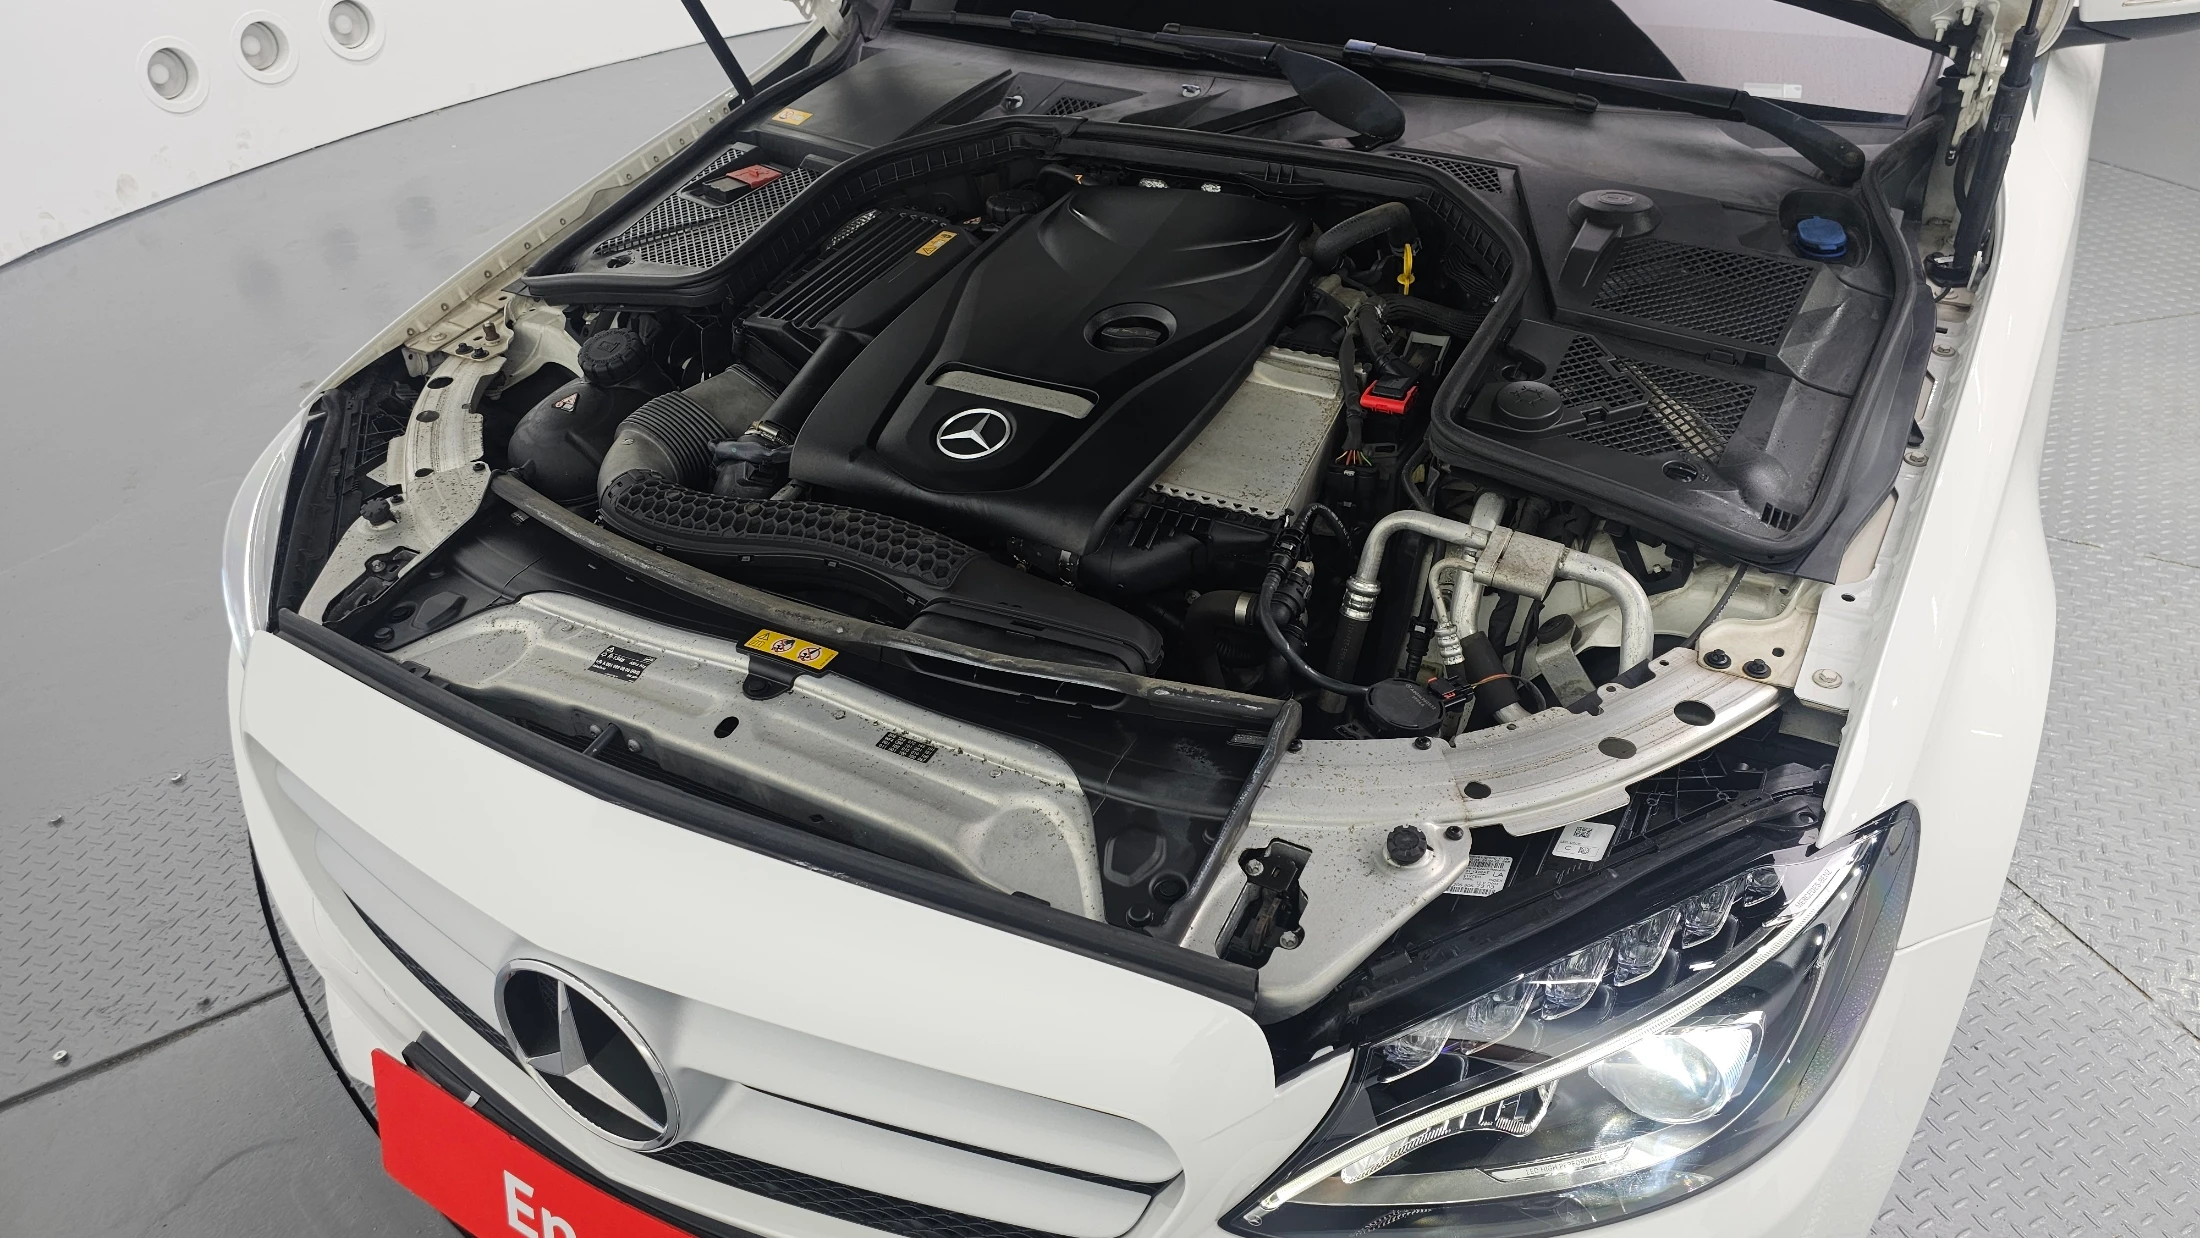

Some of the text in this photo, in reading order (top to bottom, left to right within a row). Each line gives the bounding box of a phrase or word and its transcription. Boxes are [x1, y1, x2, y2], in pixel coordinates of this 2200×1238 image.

[1794, 868, 1833, 909] MERCEDES-BENZ
[1524, 1152, 1610, 1176] LED HIGH PERFORMANCE
